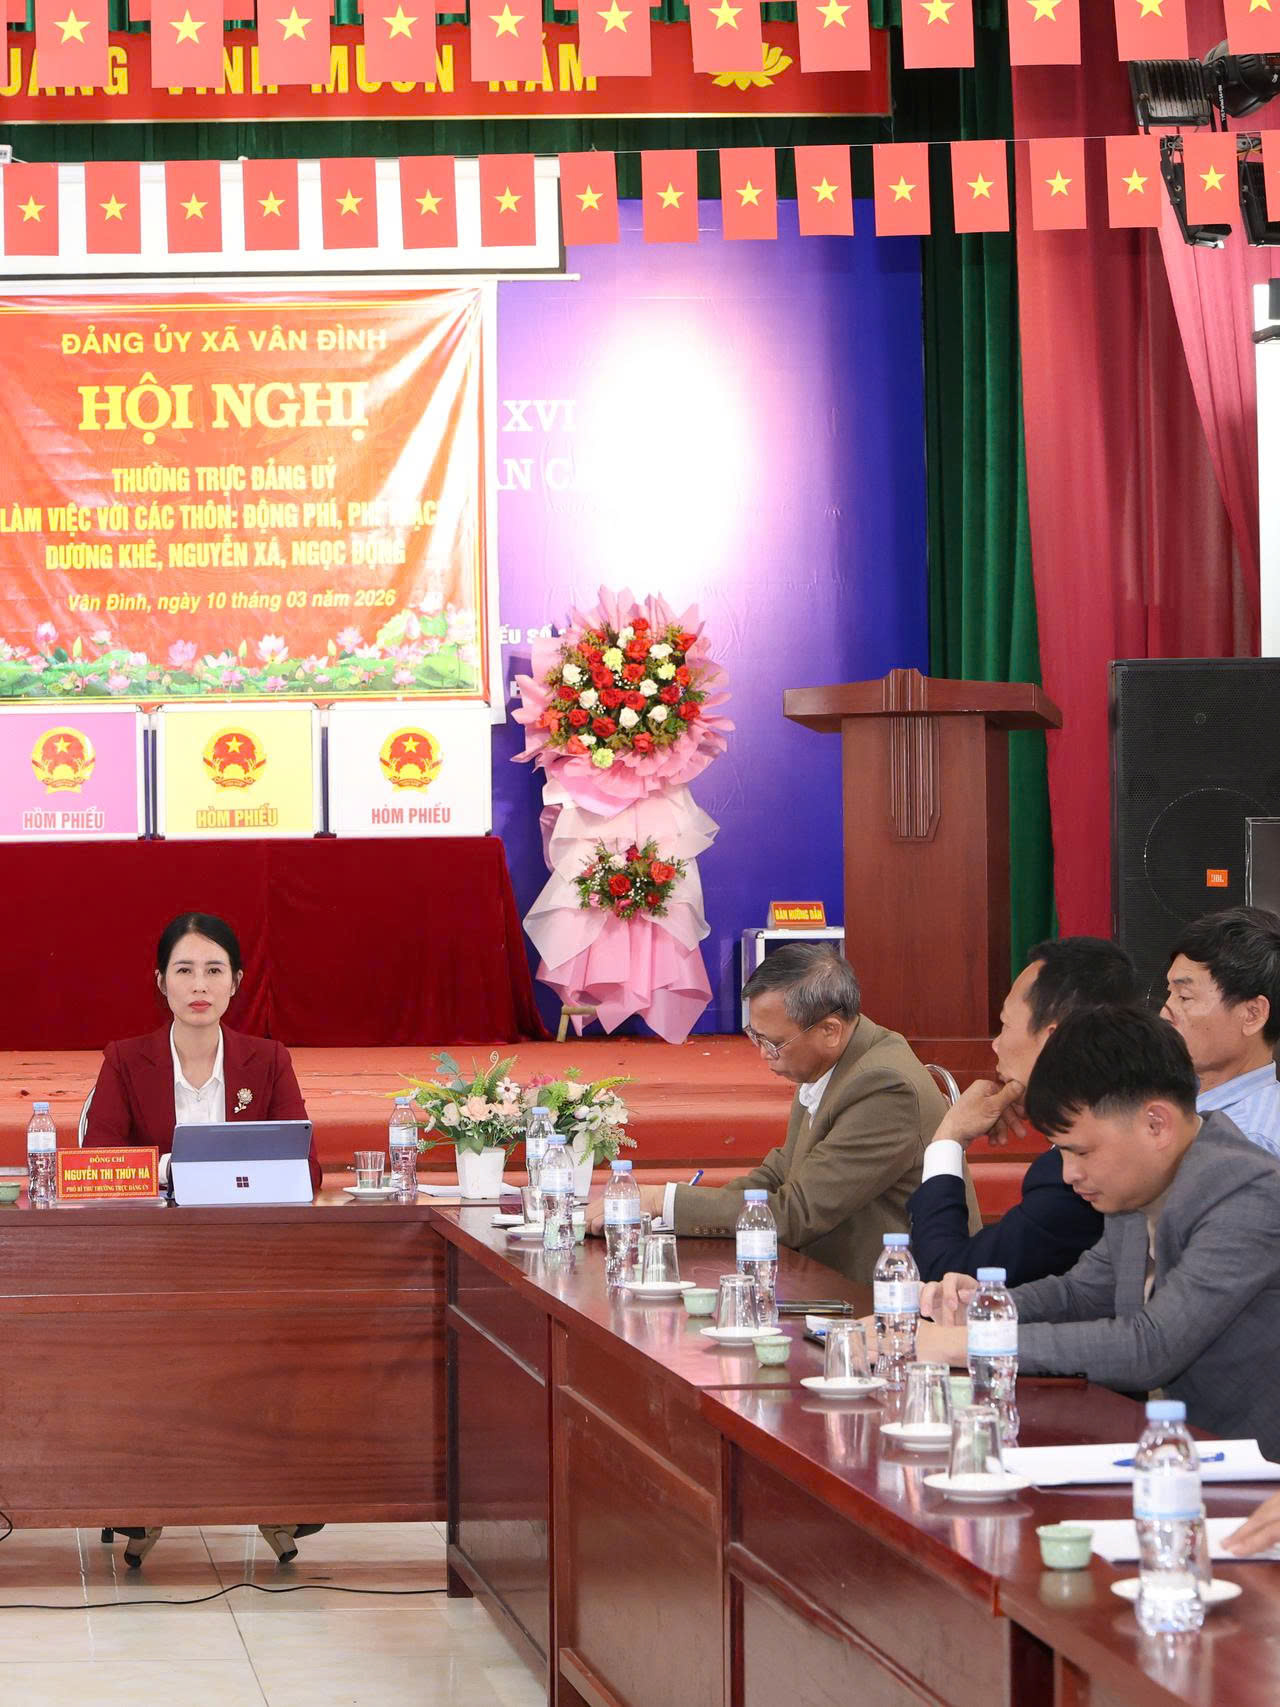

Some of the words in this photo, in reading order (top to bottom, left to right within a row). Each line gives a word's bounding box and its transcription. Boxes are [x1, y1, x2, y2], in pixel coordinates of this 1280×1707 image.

[61, 325, 145, 355] ĐẢNG
[153, 324, 193, 352] ỦY
[200, 326, 241, 352] XÃ
[248, 325, 308, 351] VÂN
[316, 324, 387, 351] ĐÌNH
[78, 372, 195, 445] HỘI
[211, 380, 369, 442] NGHỊ
[111, 462, 190, 493] THƯỜNG
[195, 464, 246, 496] TRỰC
[251, 457, 307, 491] ĐẢNG
[311, 456, 337, 490] UỶ
[0, 502, 42, 533] LÀM
[47, 502, 91, 536] VIỆC
[97, 500, 129, 531] VỚI
[134, 500, 174, 530] CÁC
[179, 499, 238, 530] THÔN:
[243, 498, 299, 534] ĐỘNG
[119, 538, 164, 572] KHÊ,
[168, 534, 248, 568] NGUYỄN
[291, 540, 347, 571] NGỌC
[68, 593, 101, 612] Vân
[106, 592, 153, 612] Đình,
[157, 593, 201, 614] ngày
[207, 592, 227, 609] 10
[231, 591, 282, 612] tháng
[286, 591, 308, 608] 03
[312, 590, 350, 607] năm
[354, 589, 397, 606] 2026
[61, 806, 104, 830] PHIẾU
[64, 1166, 98, 1180] NGUYỄN
[99, 1168, 113, 1181] THỊ
